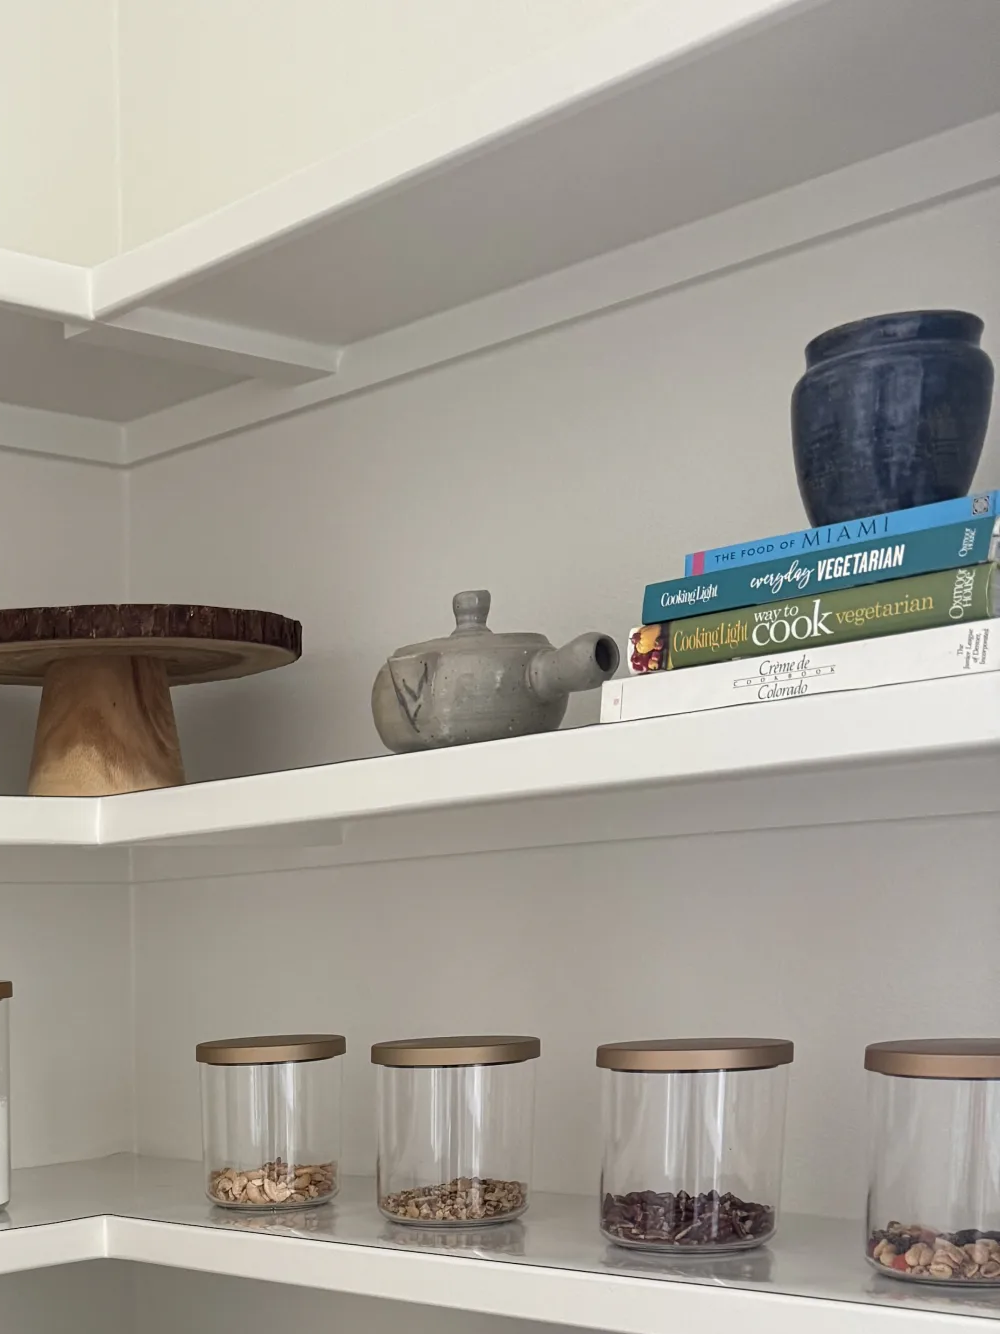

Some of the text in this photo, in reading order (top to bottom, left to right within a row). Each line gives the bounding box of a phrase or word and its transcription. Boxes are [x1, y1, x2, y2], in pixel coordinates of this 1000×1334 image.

[715, 517, 889, 564] THE FOOD OF MIAMI
[661, 543, 906, 608] Cooking Light everyday VEGETARIAN
[949, 568, 968, 620] Oxmoor
[673, 604, 799, 653] Cooking Light way to
[752, 594, 935, 647] cook vegetarian
[733, 666, 836, 688] COOKBOOK
[759, 654, 811, 676] Crème de
[758, 680, 808, 701] Colorado
